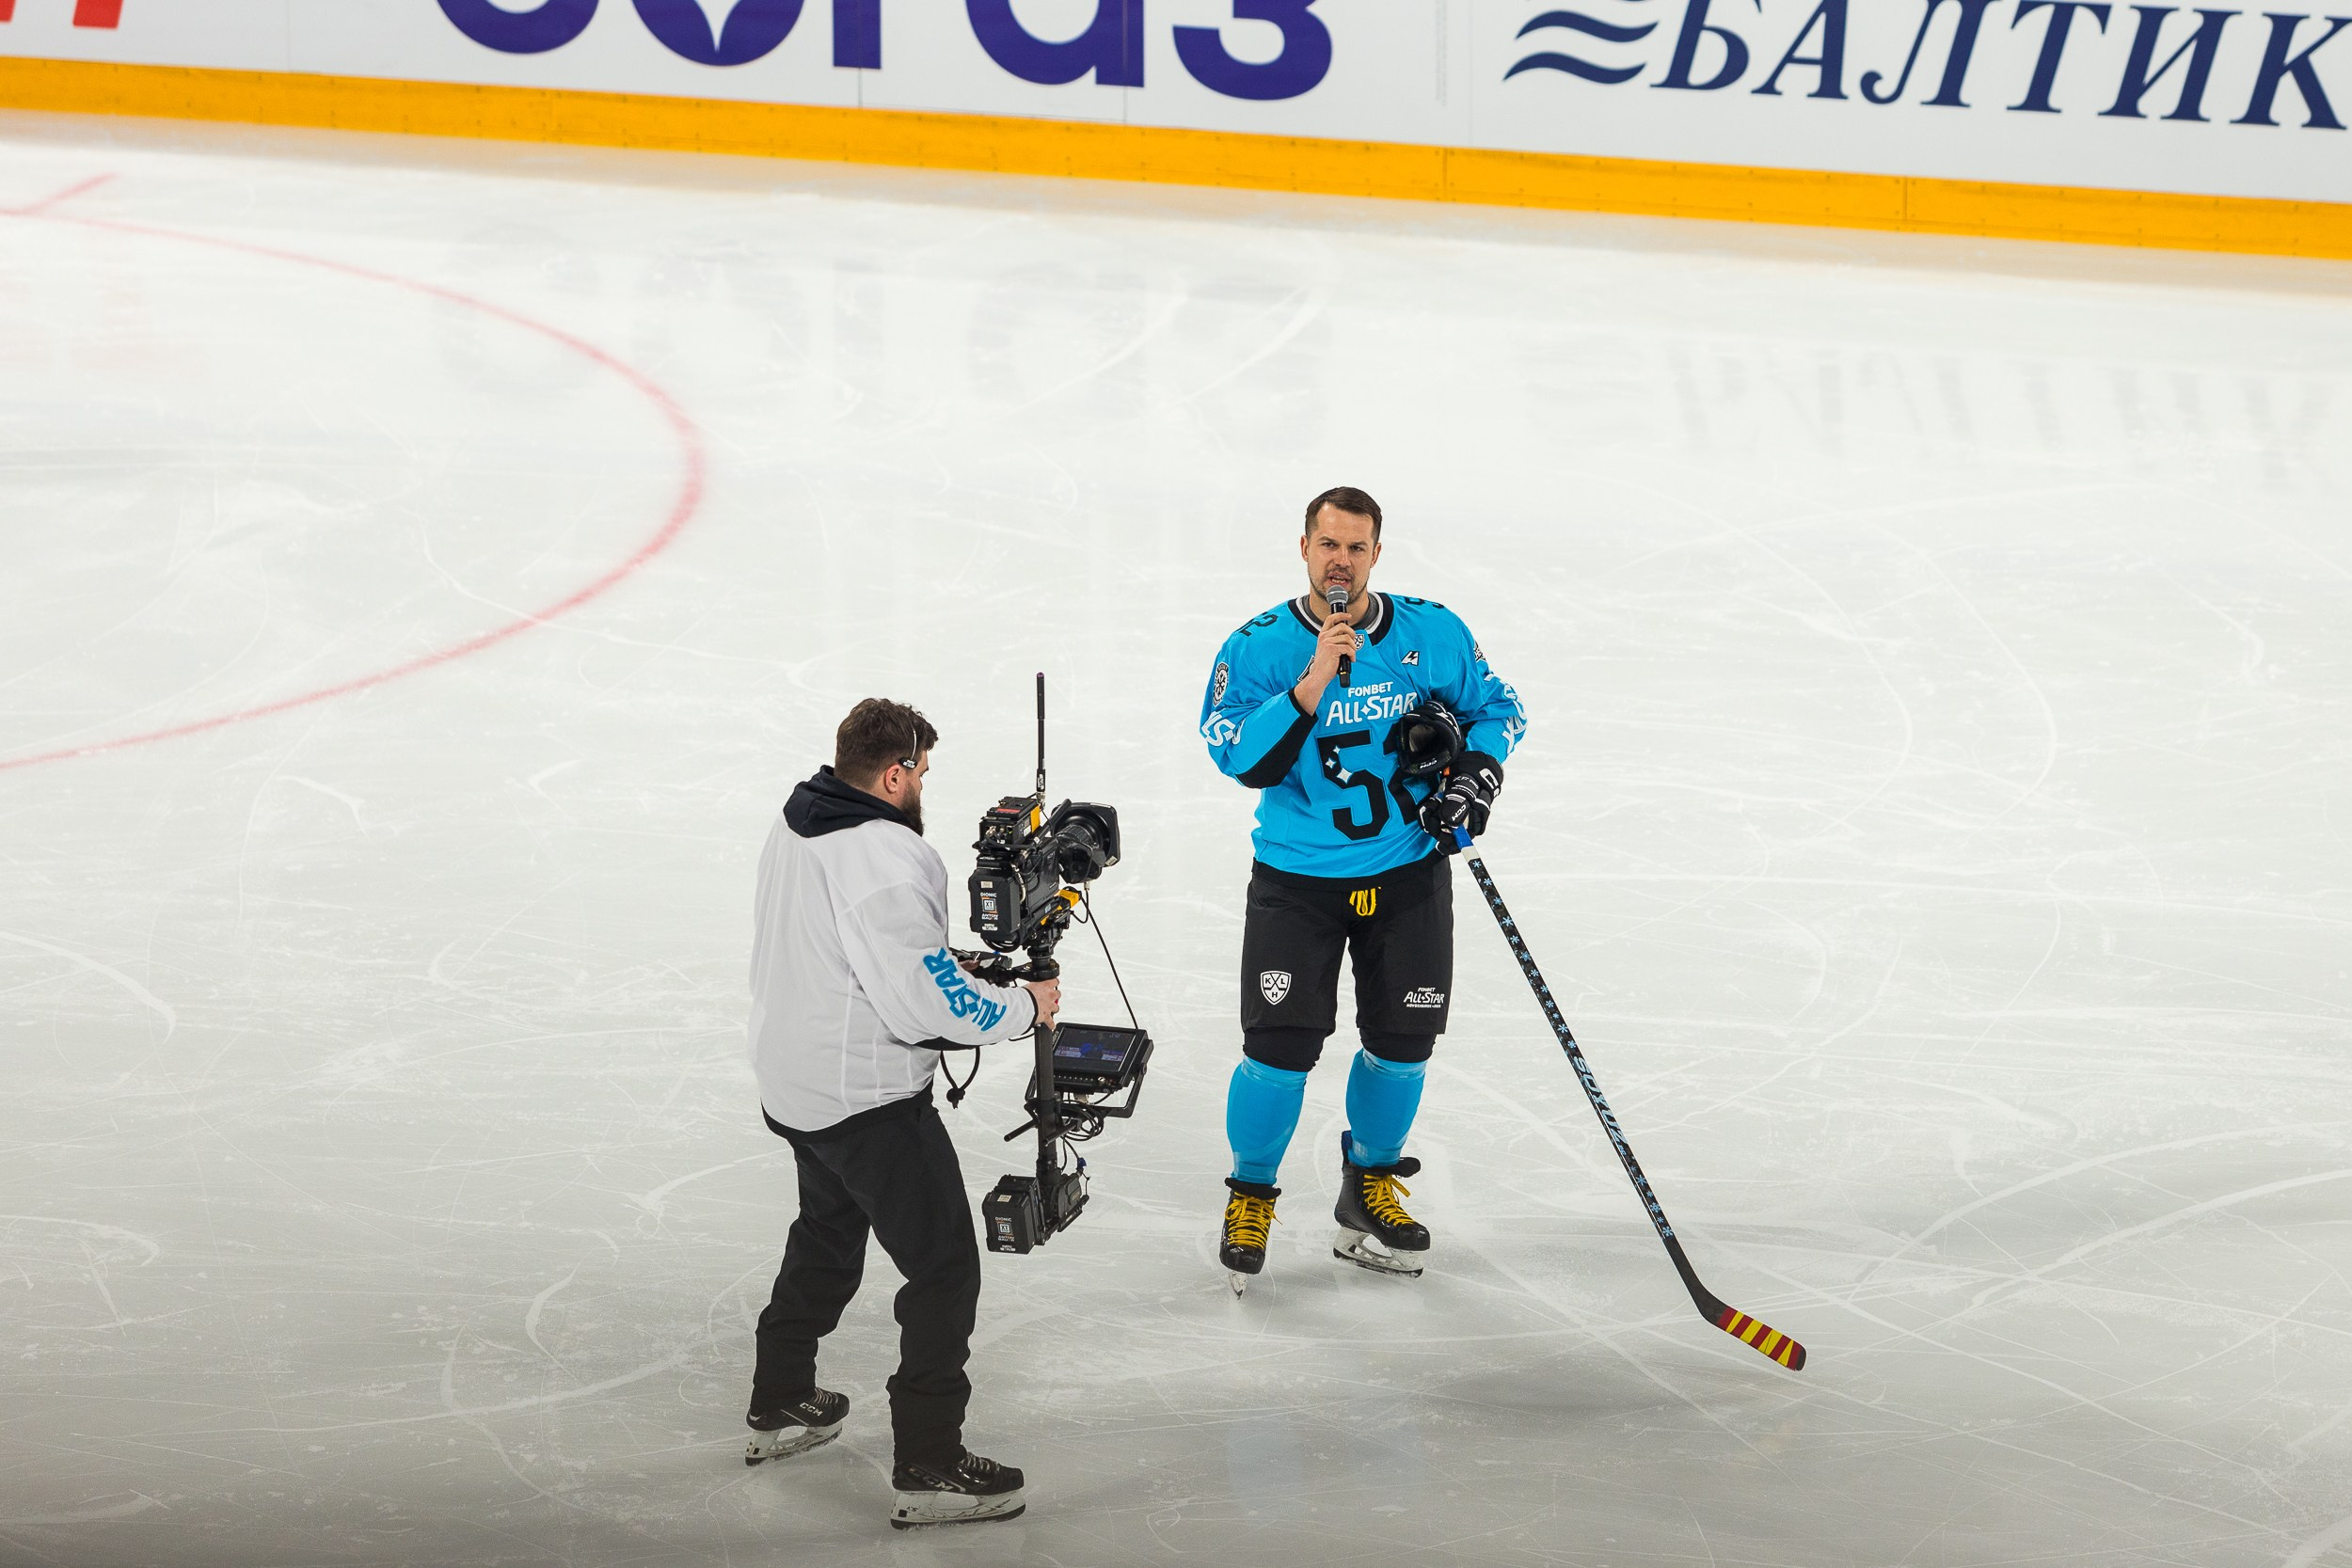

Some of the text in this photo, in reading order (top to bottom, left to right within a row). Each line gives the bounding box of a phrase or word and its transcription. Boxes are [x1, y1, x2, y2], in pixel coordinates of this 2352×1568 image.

[1650, 0, 2352, 130] БАЛТИК
[1348, 682, 1393, 698] FONBET
[1452, 804, 1466, 821] CCM
[1573, 1056, 1628, 1144] SOYUZ
[800, 1402, 823, 1417] CCM
